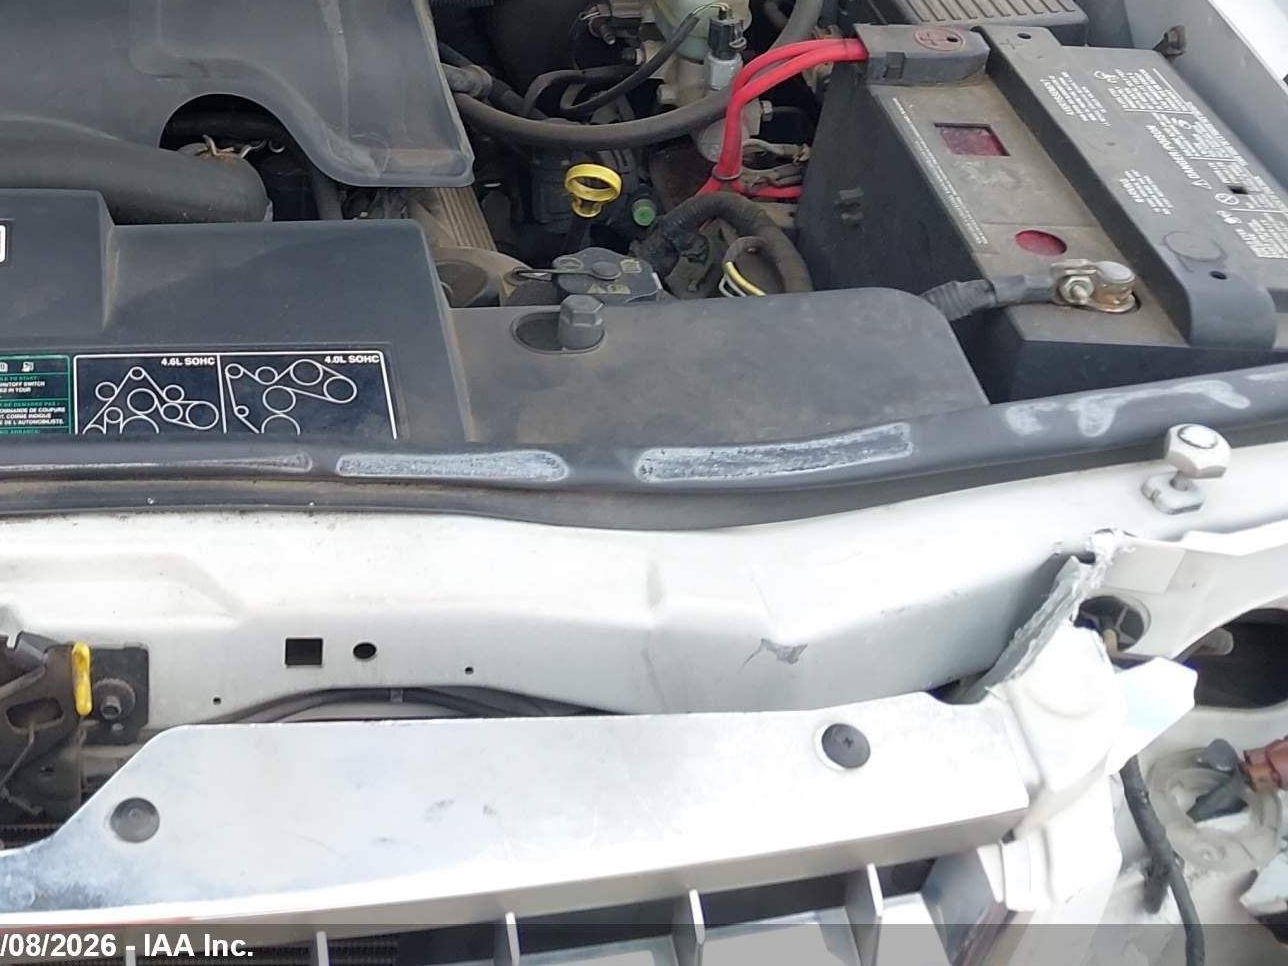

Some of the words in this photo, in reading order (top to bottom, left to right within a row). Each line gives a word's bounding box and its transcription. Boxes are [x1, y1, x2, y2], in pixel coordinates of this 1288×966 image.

[160, 357, 183, 367] 4.6L
[184, 356, 216, 367] SOHC
[324, 354, 347, 365] 4.0L
[348, 354, 381, 364] SOHC
